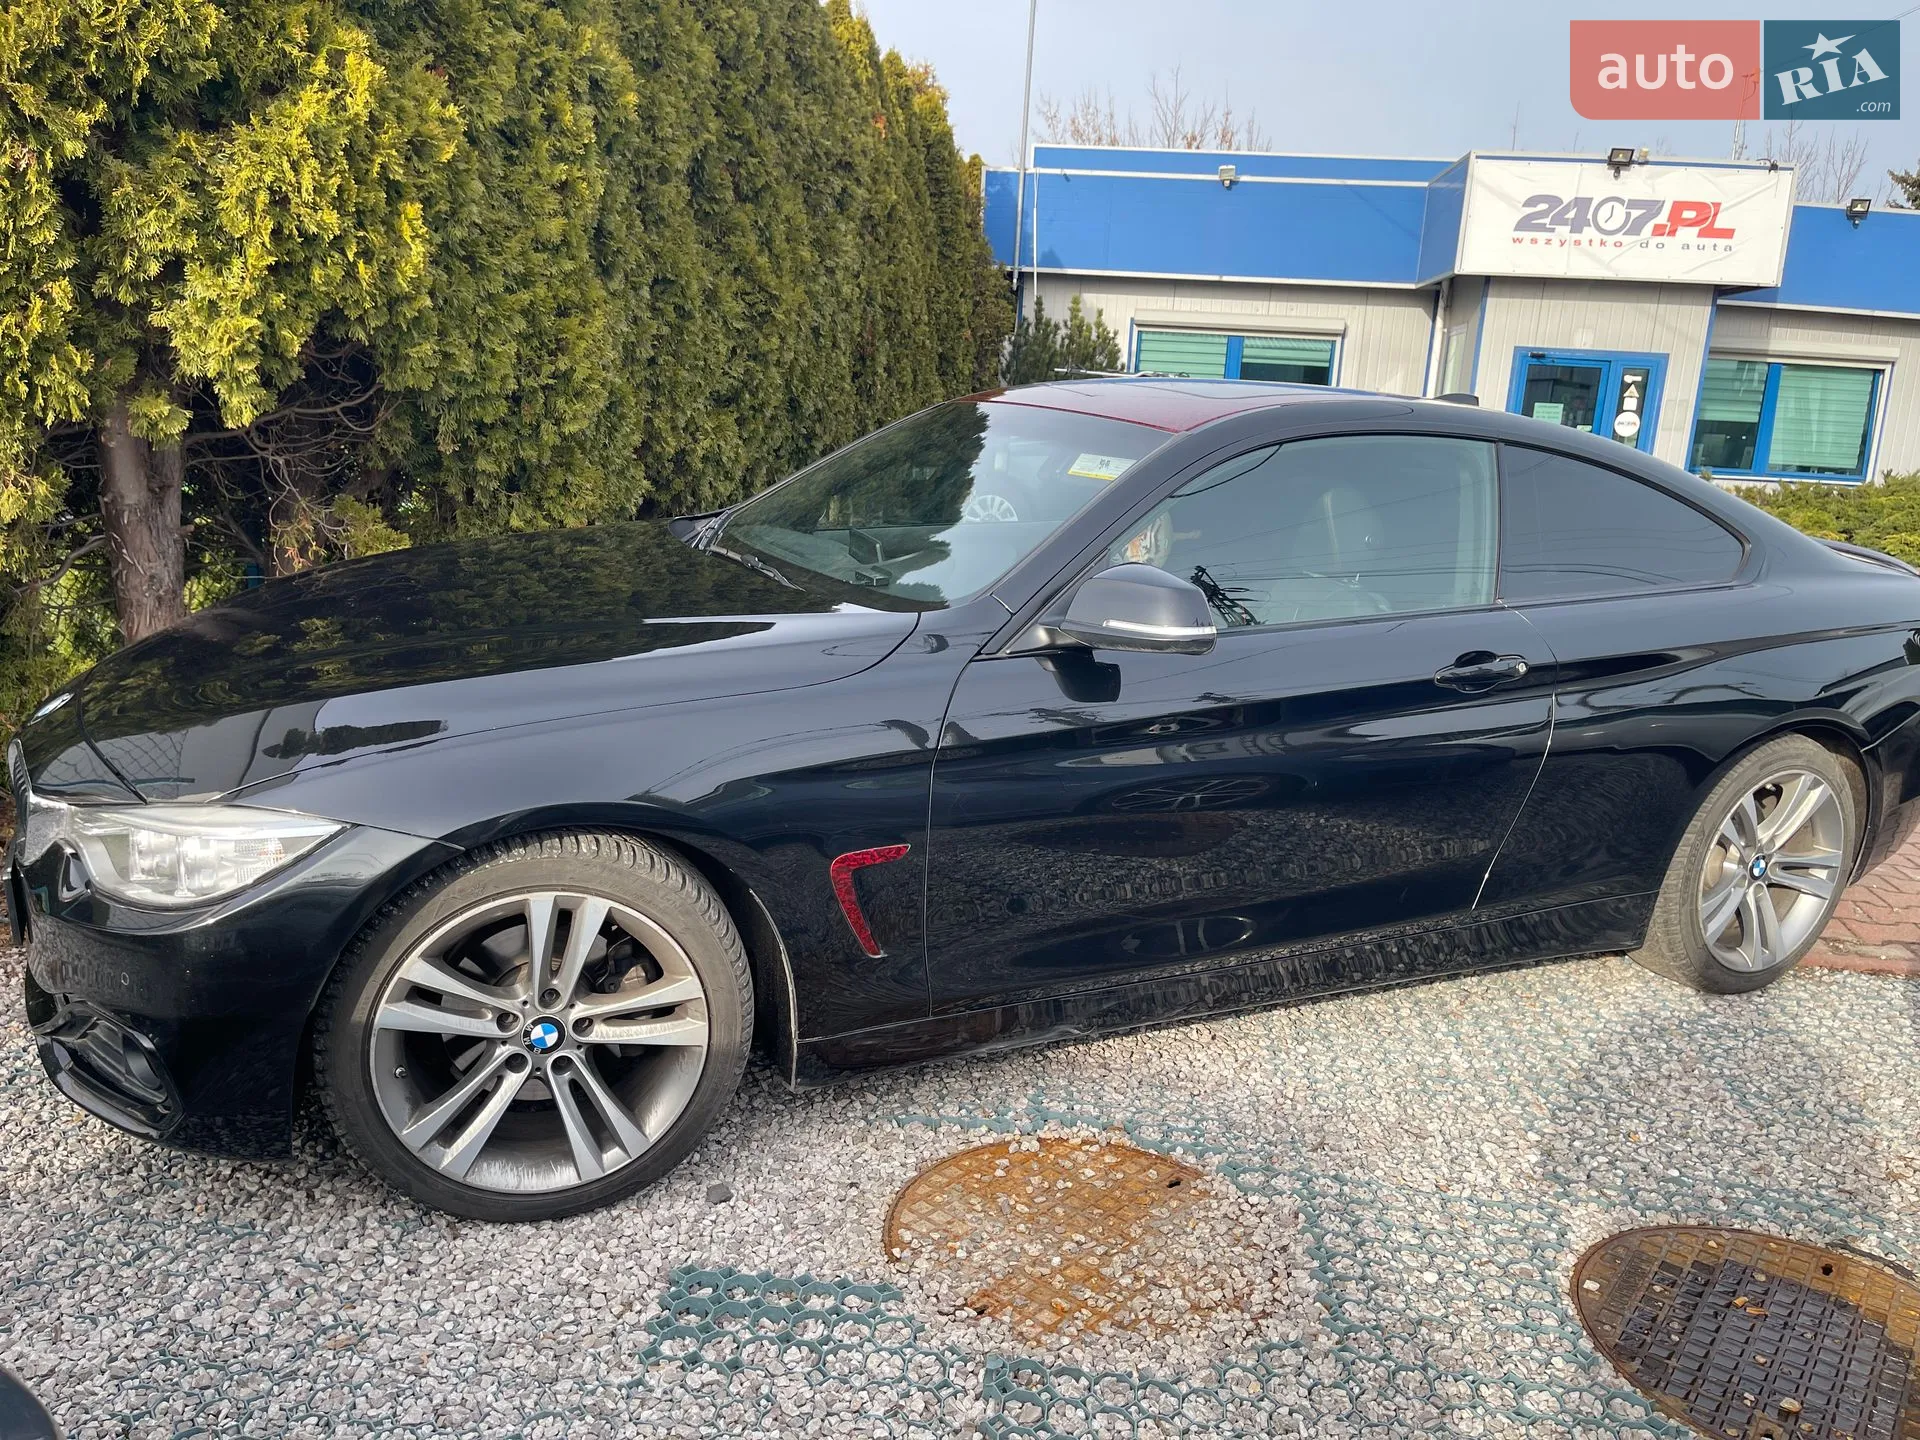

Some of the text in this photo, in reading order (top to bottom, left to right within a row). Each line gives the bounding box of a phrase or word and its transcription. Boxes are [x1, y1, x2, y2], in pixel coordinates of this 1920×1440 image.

[1512, 236, 1733, 252] wszystko do auta
